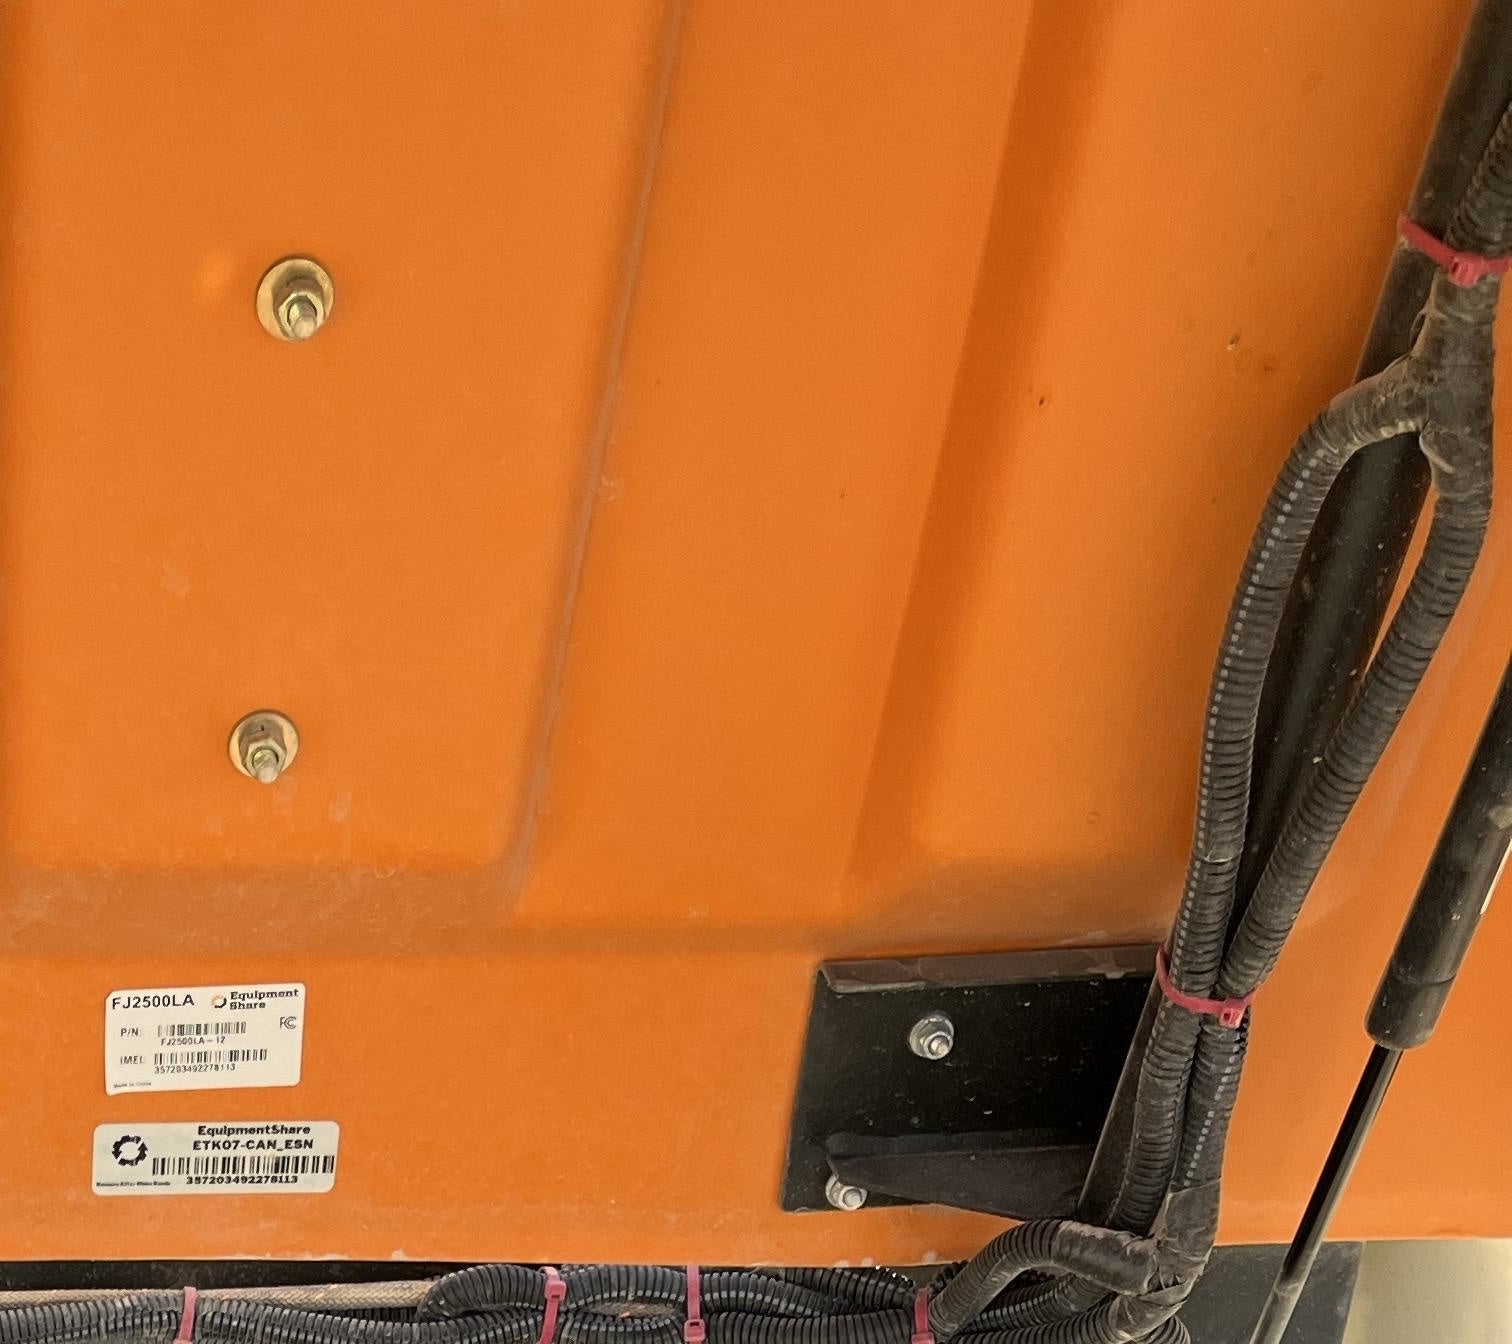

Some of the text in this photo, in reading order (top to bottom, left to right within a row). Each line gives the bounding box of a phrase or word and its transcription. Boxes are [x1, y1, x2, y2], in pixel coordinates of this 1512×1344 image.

[112, 990, 299, 1010] FJ2500LA Equipment
[230, 1001, 266, 1010] Share
[198, 1125, 310, 1136] EquipmentShare
